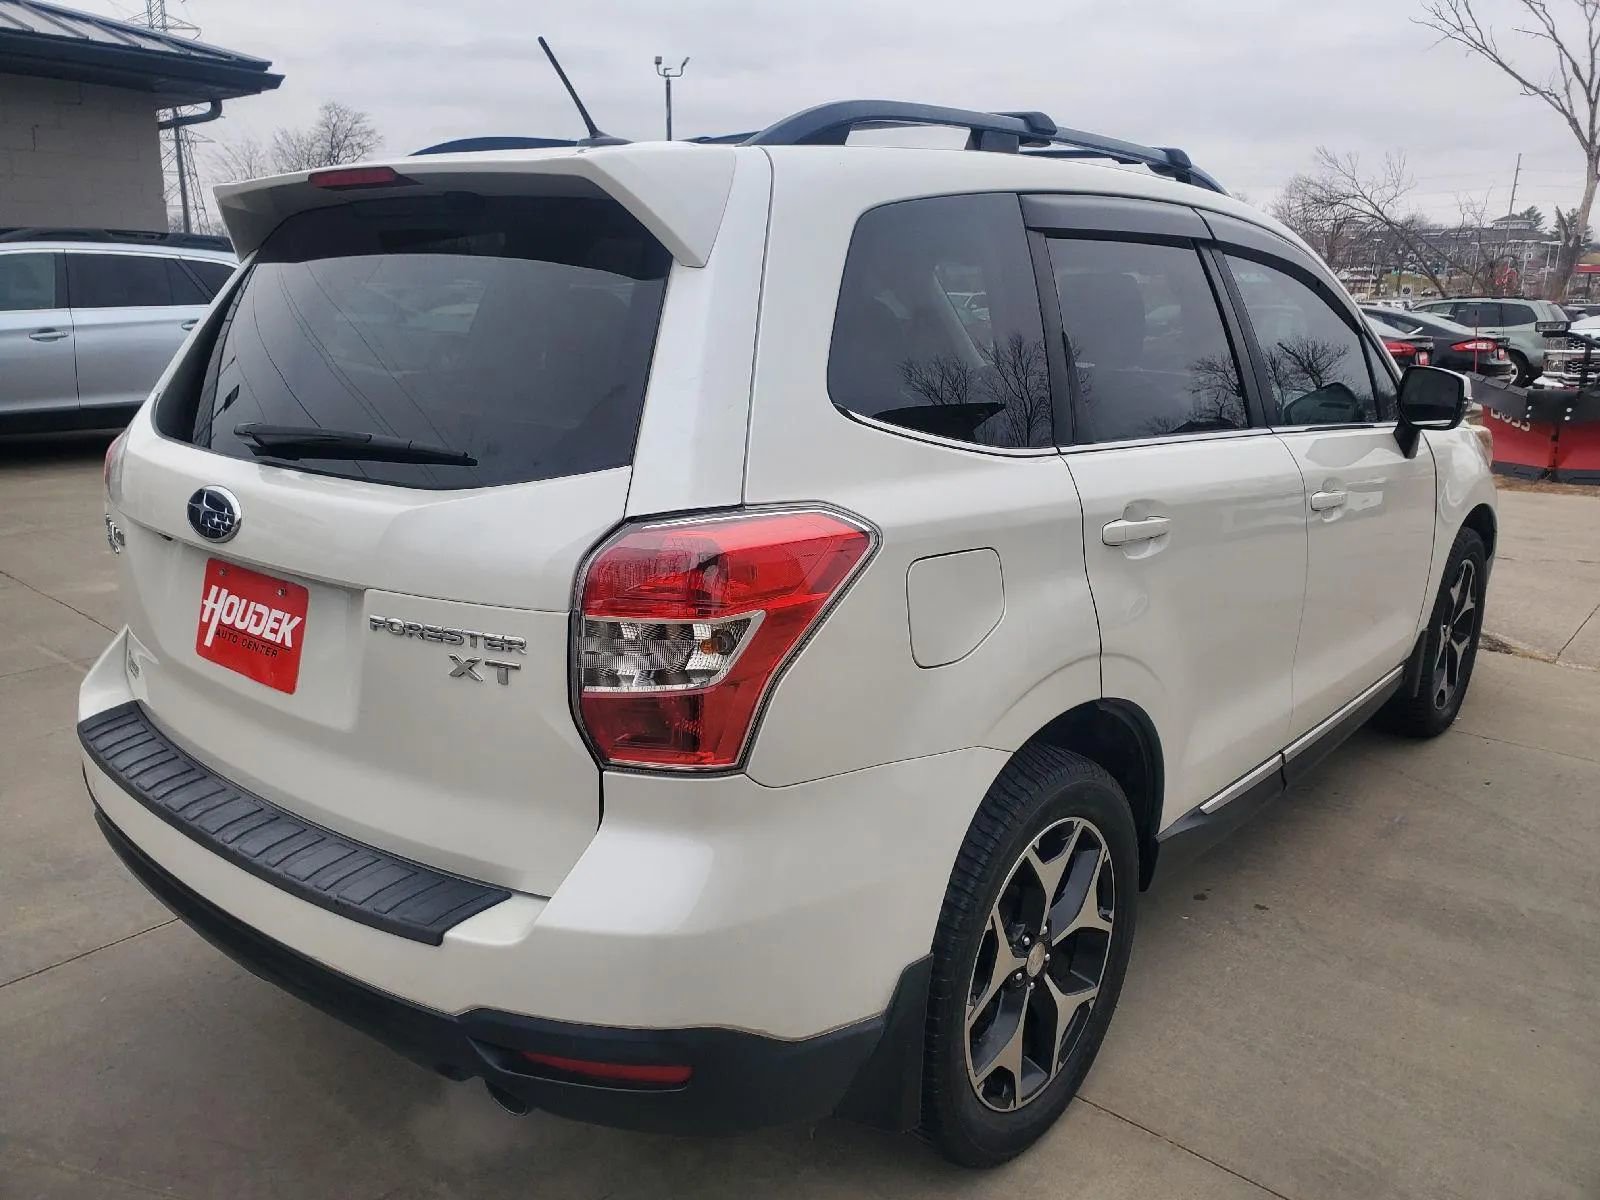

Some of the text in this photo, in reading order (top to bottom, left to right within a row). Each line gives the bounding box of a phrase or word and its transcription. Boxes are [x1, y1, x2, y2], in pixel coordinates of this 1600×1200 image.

[201, 585, 302, 648] HOUDEK
[369, 614, 527, 655] FORESTER
[215, 628, 278, 657] AUTO CENTER
[448, 653, 521, 685] XT
